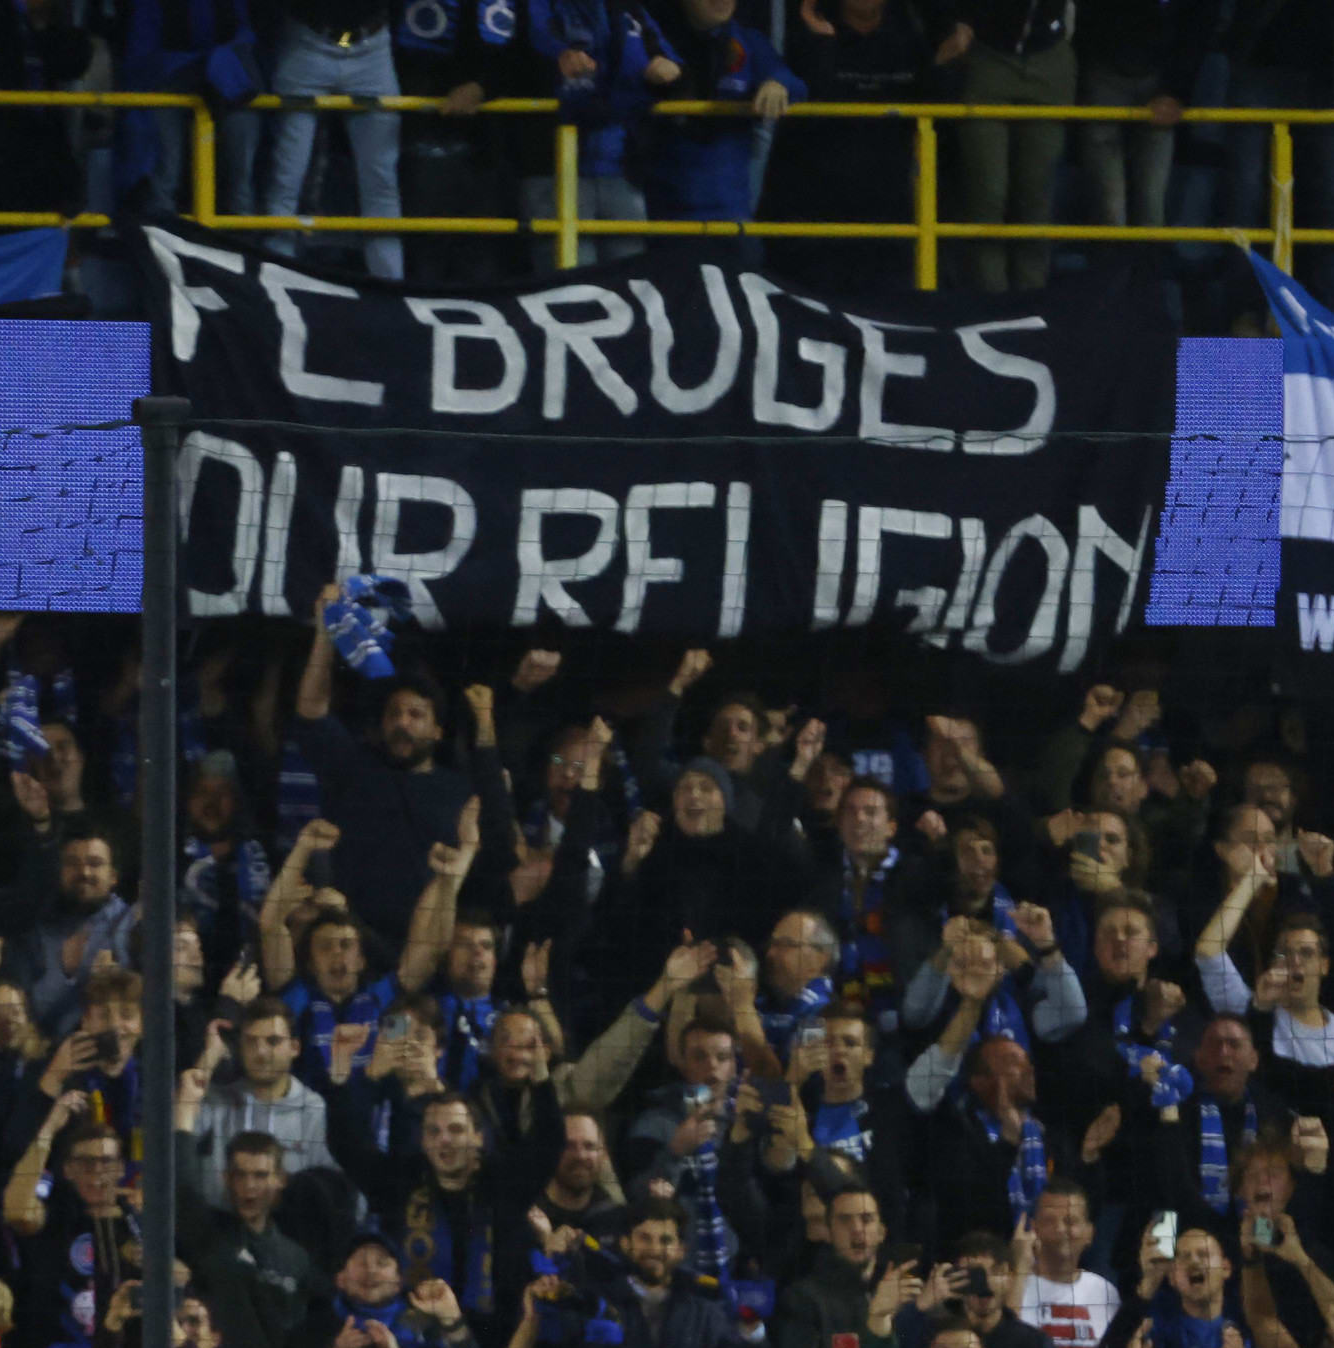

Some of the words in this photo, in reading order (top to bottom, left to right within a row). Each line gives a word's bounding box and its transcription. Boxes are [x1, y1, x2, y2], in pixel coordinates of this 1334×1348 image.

[142, 225, 384, 404] FC
[402, 264, 1057, 455] BRUGES
[178, 431, 477, 631] OUR
